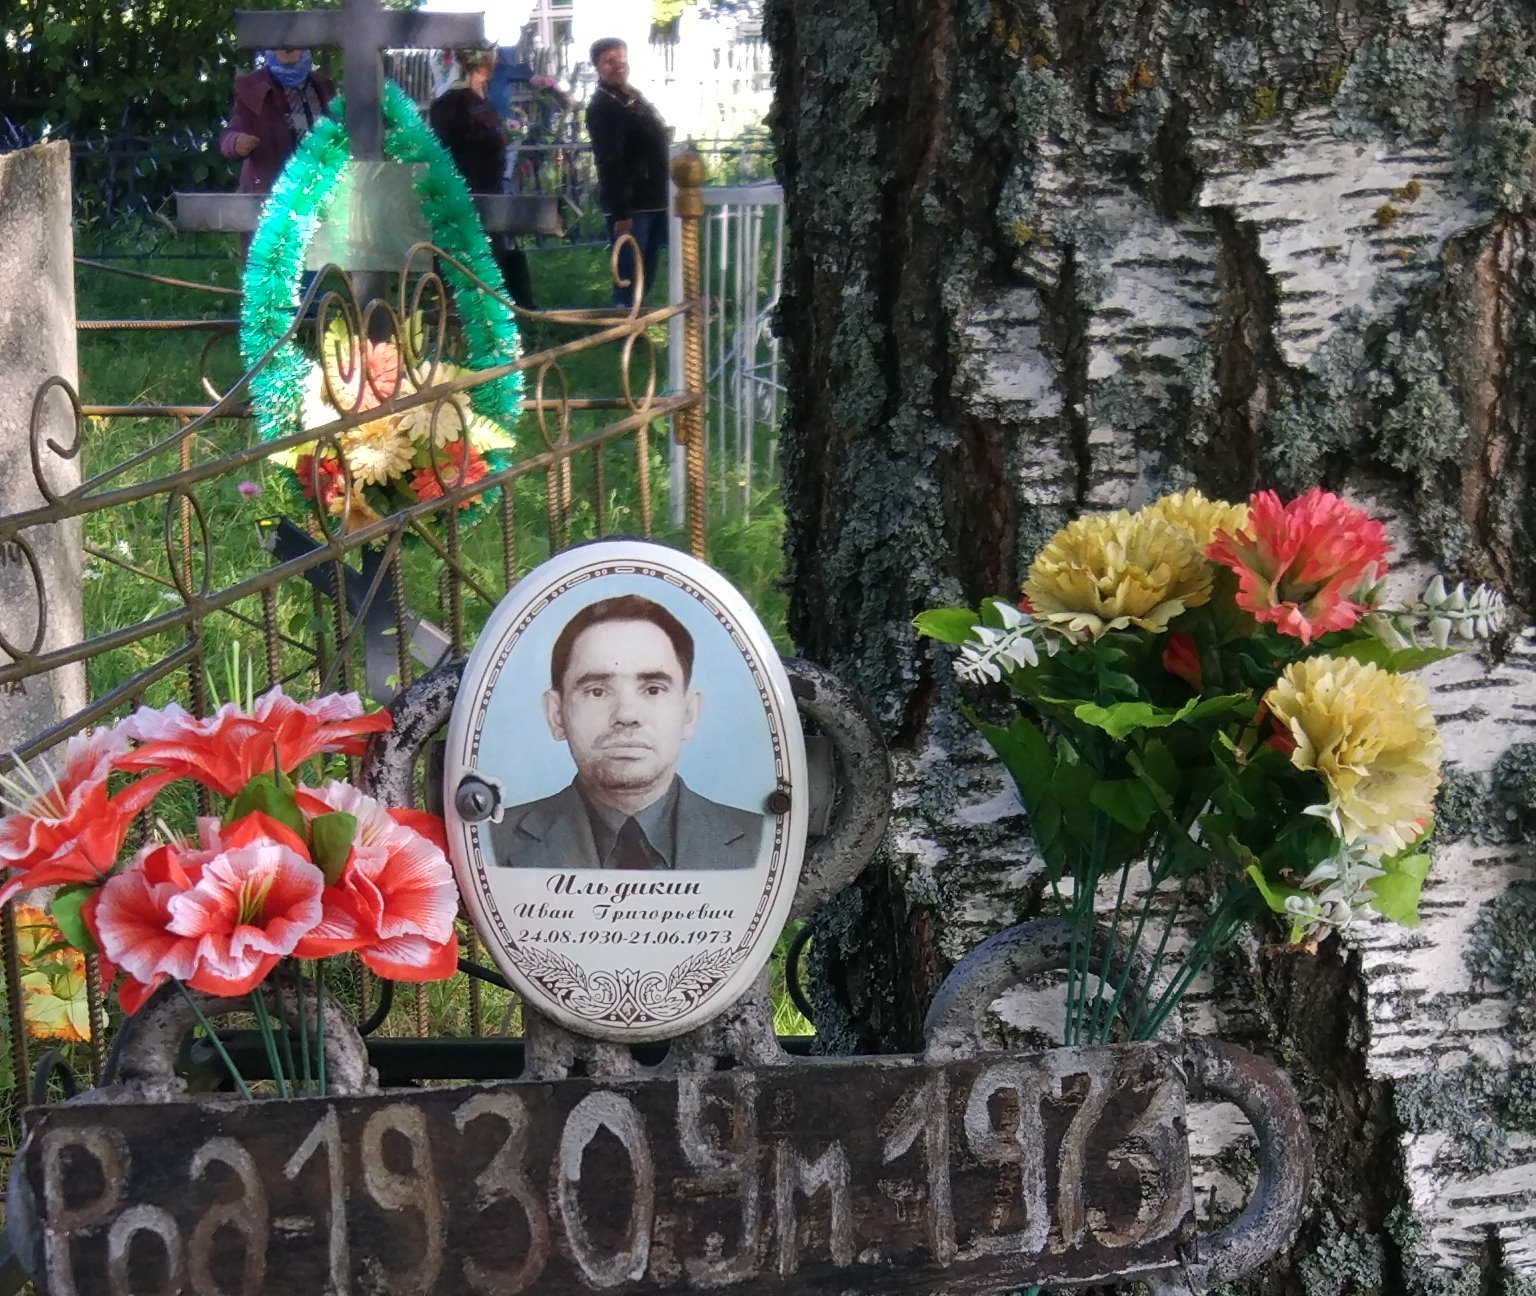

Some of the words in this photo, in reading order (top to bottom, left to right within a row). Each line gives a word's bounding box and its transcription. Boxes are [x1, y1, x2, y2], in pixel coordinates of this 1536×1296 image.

[546, 873, 702, 903] Ильдикин
[513, 902, 575, 920] Иван
[592, 902, 736, 923] Григорьевич
[517, 929, 732, 944] 24.08.1930-21.06.1973
